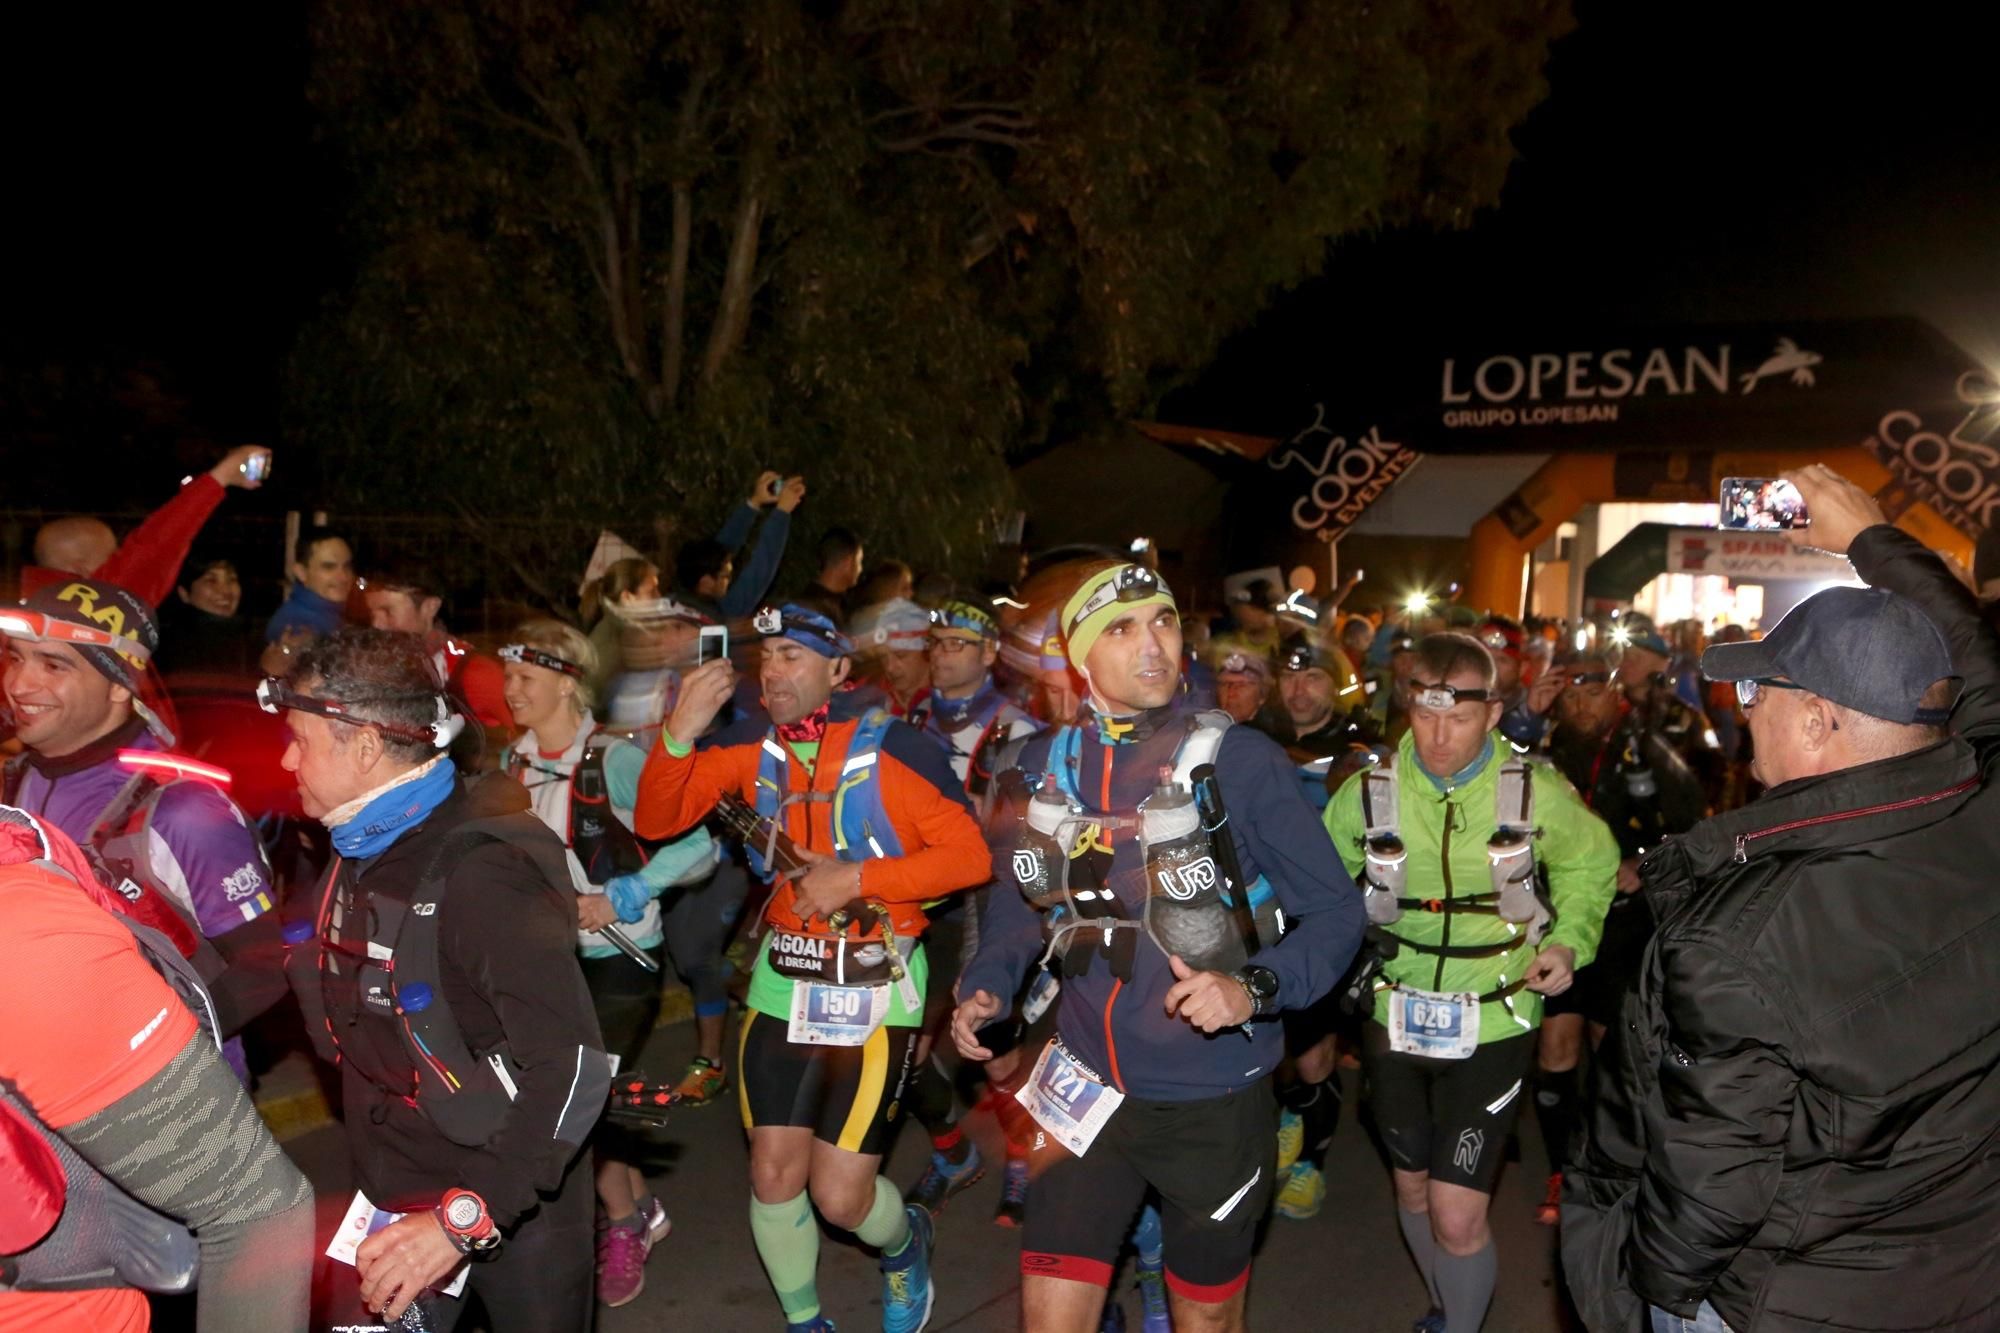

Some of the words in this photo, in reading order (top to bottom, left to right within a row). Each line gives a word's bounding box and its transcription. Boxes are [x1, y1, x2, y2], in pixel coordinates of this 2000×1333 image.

[1442, 344, 1731, 402] LOPESAN
[1443, 408, 1516, 427] GRUPO
[1520, 405, 1619, 425] LOPESAN
[1292, 425, 1400, 529] COOK
[1335, 449, 1416, 523] EVENTS
[1879, 410, 2000, 528] COOK
[1721, 539, 1786, 556] SPAIN
[785, 956, 823, 971] DREAM
[819, 989, 861, 1017] 150
[1413, 1002, 1452, 1029] 626
[1047, 1059, 1090, 1103] 121
